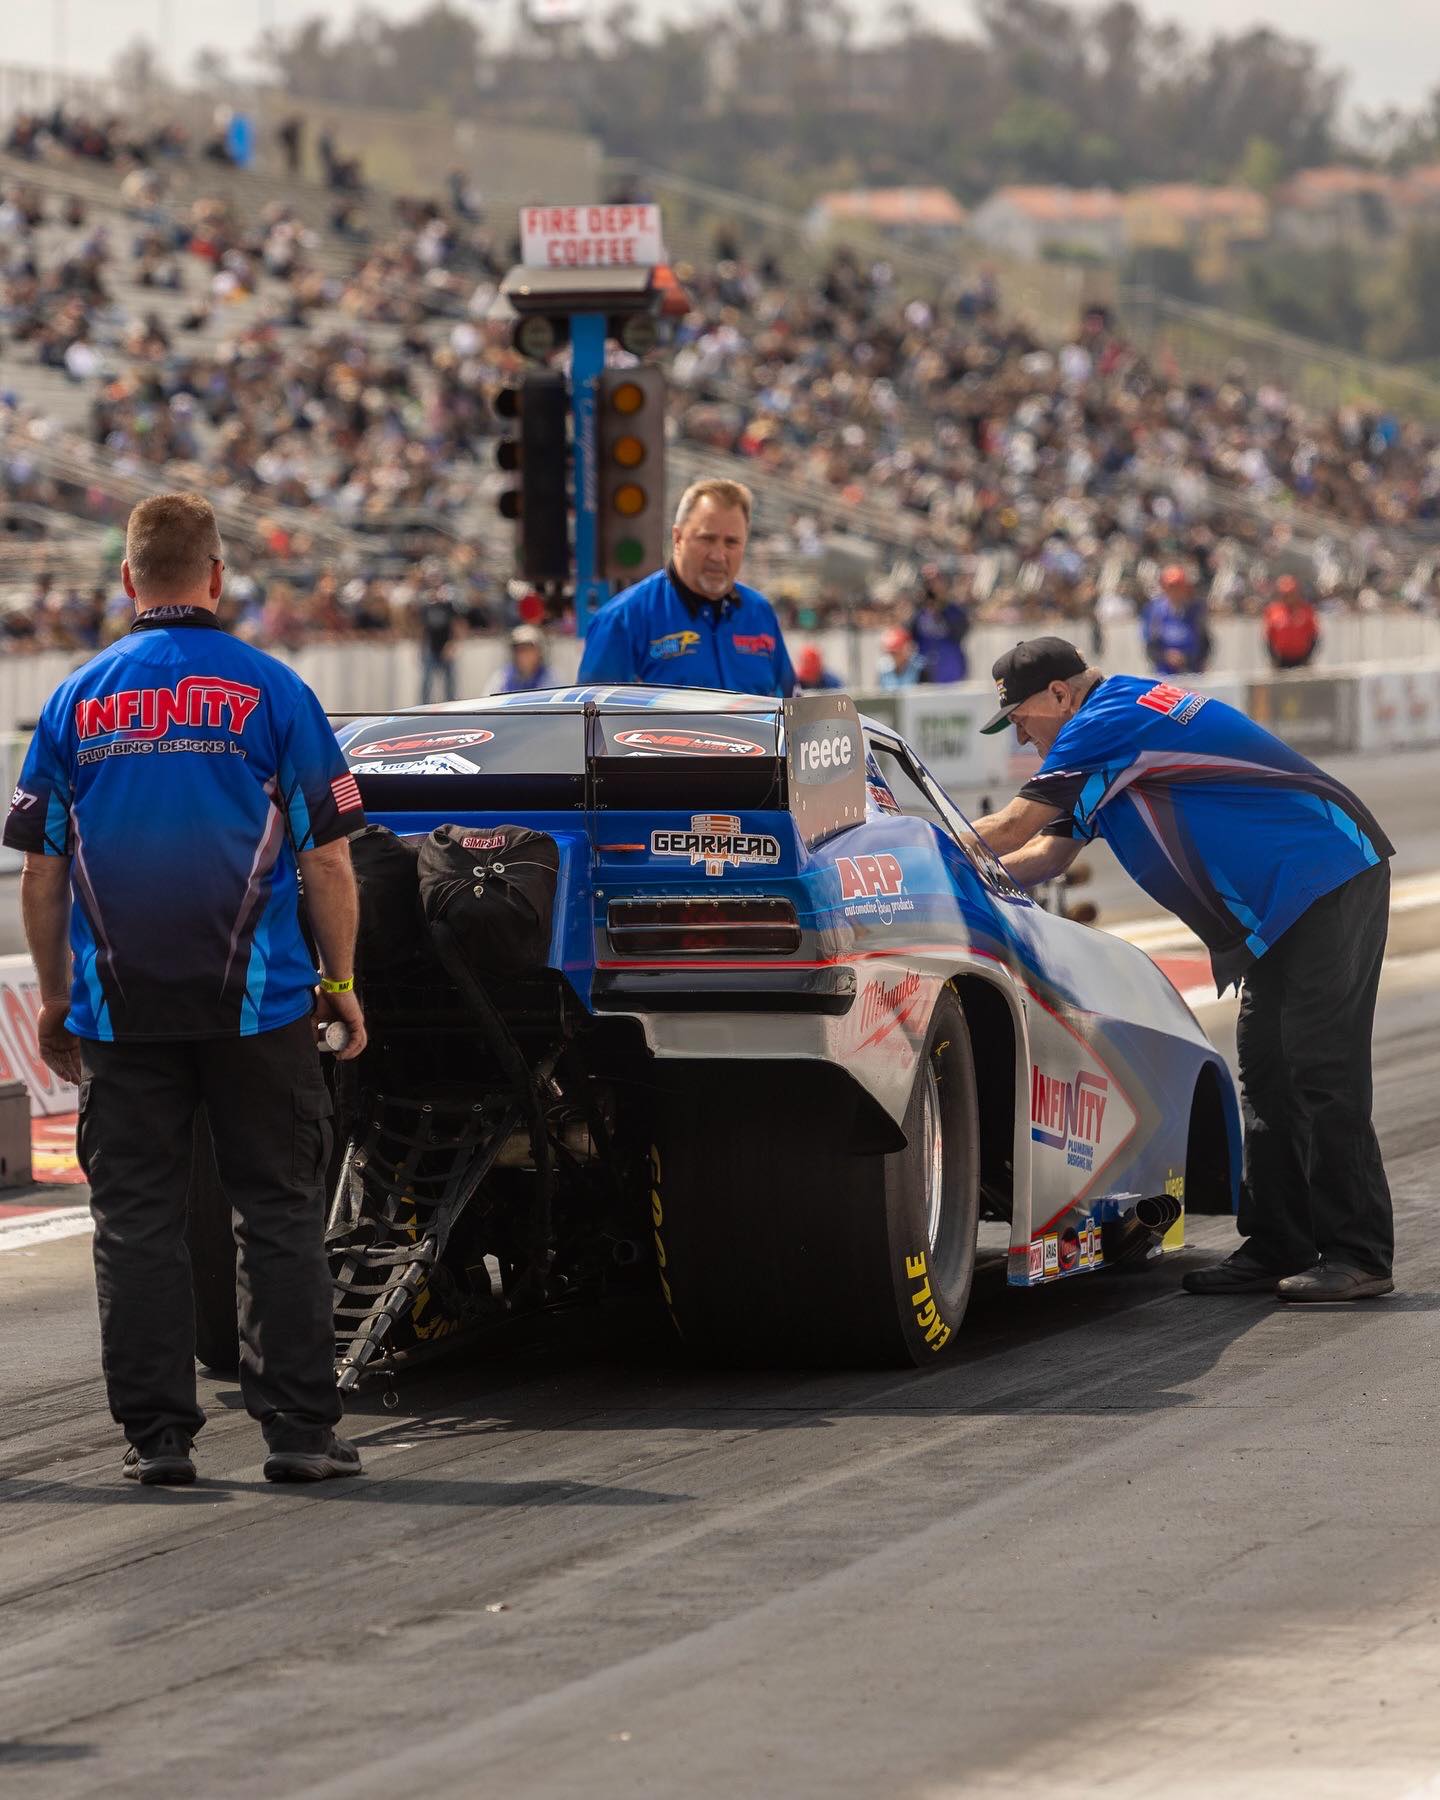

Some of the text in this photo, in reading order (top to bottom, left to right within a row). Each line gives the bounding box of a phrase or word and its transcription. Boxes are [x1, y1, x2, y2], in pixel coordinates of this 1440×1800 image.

[527, 206, 655, 234] FIRE DEPT.
[547, 237, 637, 266] COFFEE
[75, 676, 261, 744] INFINITY
[158, 738, 226, 754] DESIGNS
[800, 735, 852, 771] reece
[464, 835, 503, 848] SIMPSON
[654, 833, 778, 857] GEARHEAD
[835, 853, 904, 900] ARP
[858, 967, 921, 1034] Milwaukee
[1031, 1064, 1108, 1150] INFINITY
[905, 1250, 951, 1352] EAGLE
